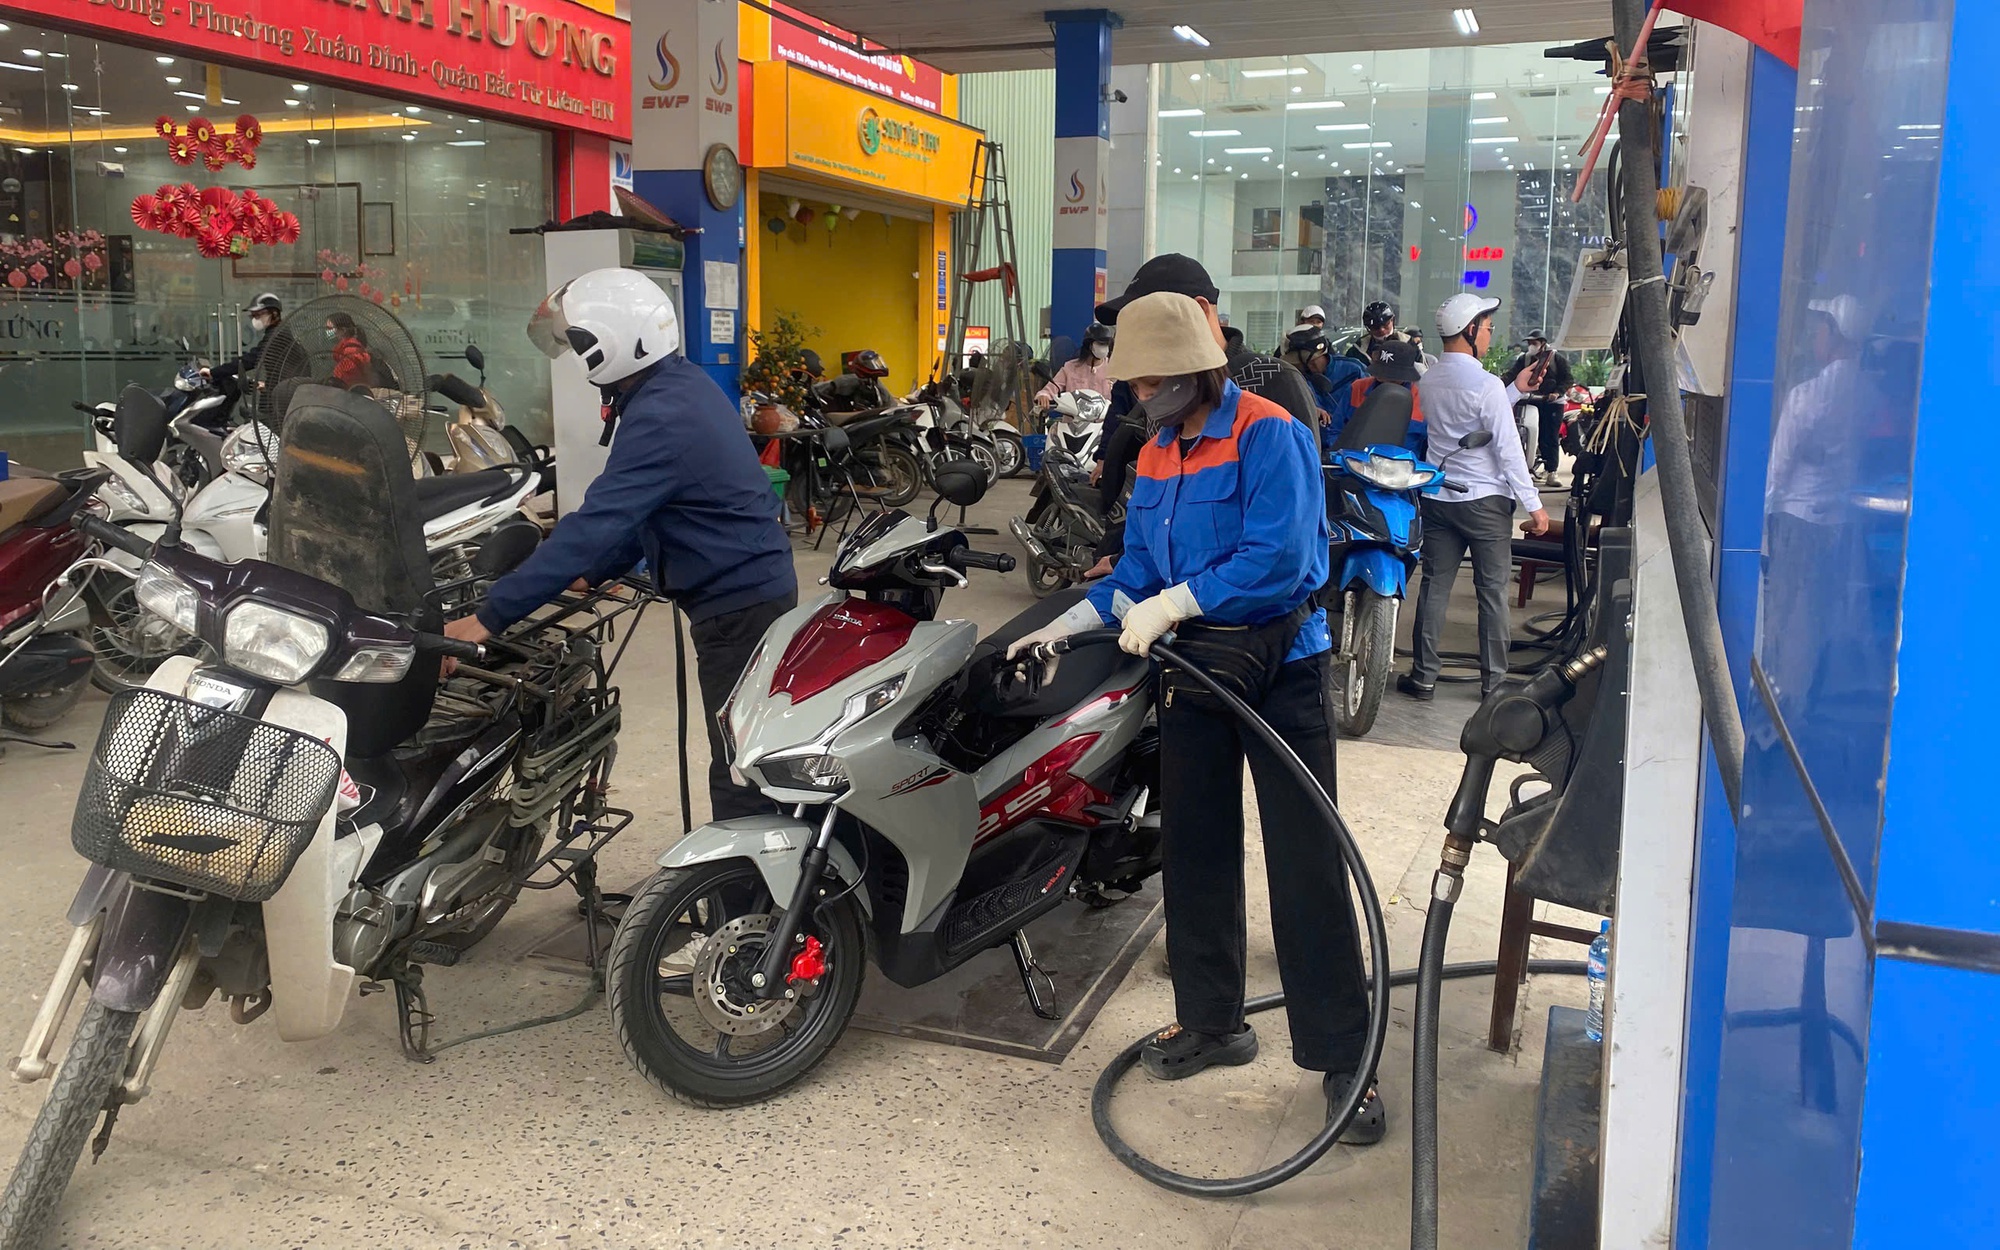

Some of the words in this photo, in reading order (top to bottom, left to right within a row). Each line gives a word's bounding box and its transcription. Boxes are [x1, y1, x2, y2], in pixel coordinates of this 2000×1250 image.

[189, 0, 294, 55] Phường
[302, 26, 362, 65] Xuân
[431, 59, 480, 93] Quận
[484, 69, 515, 98] Bắc
[518, 79, 543, 105] Từ
[642, 95, 690, 109] SWP
[705, 97, 733, 115] SWP
[1059, 206, 1089, 215] SWP
[192, 678, 231, 695] HONDA
[891, 765, 930, 792] SPORT
